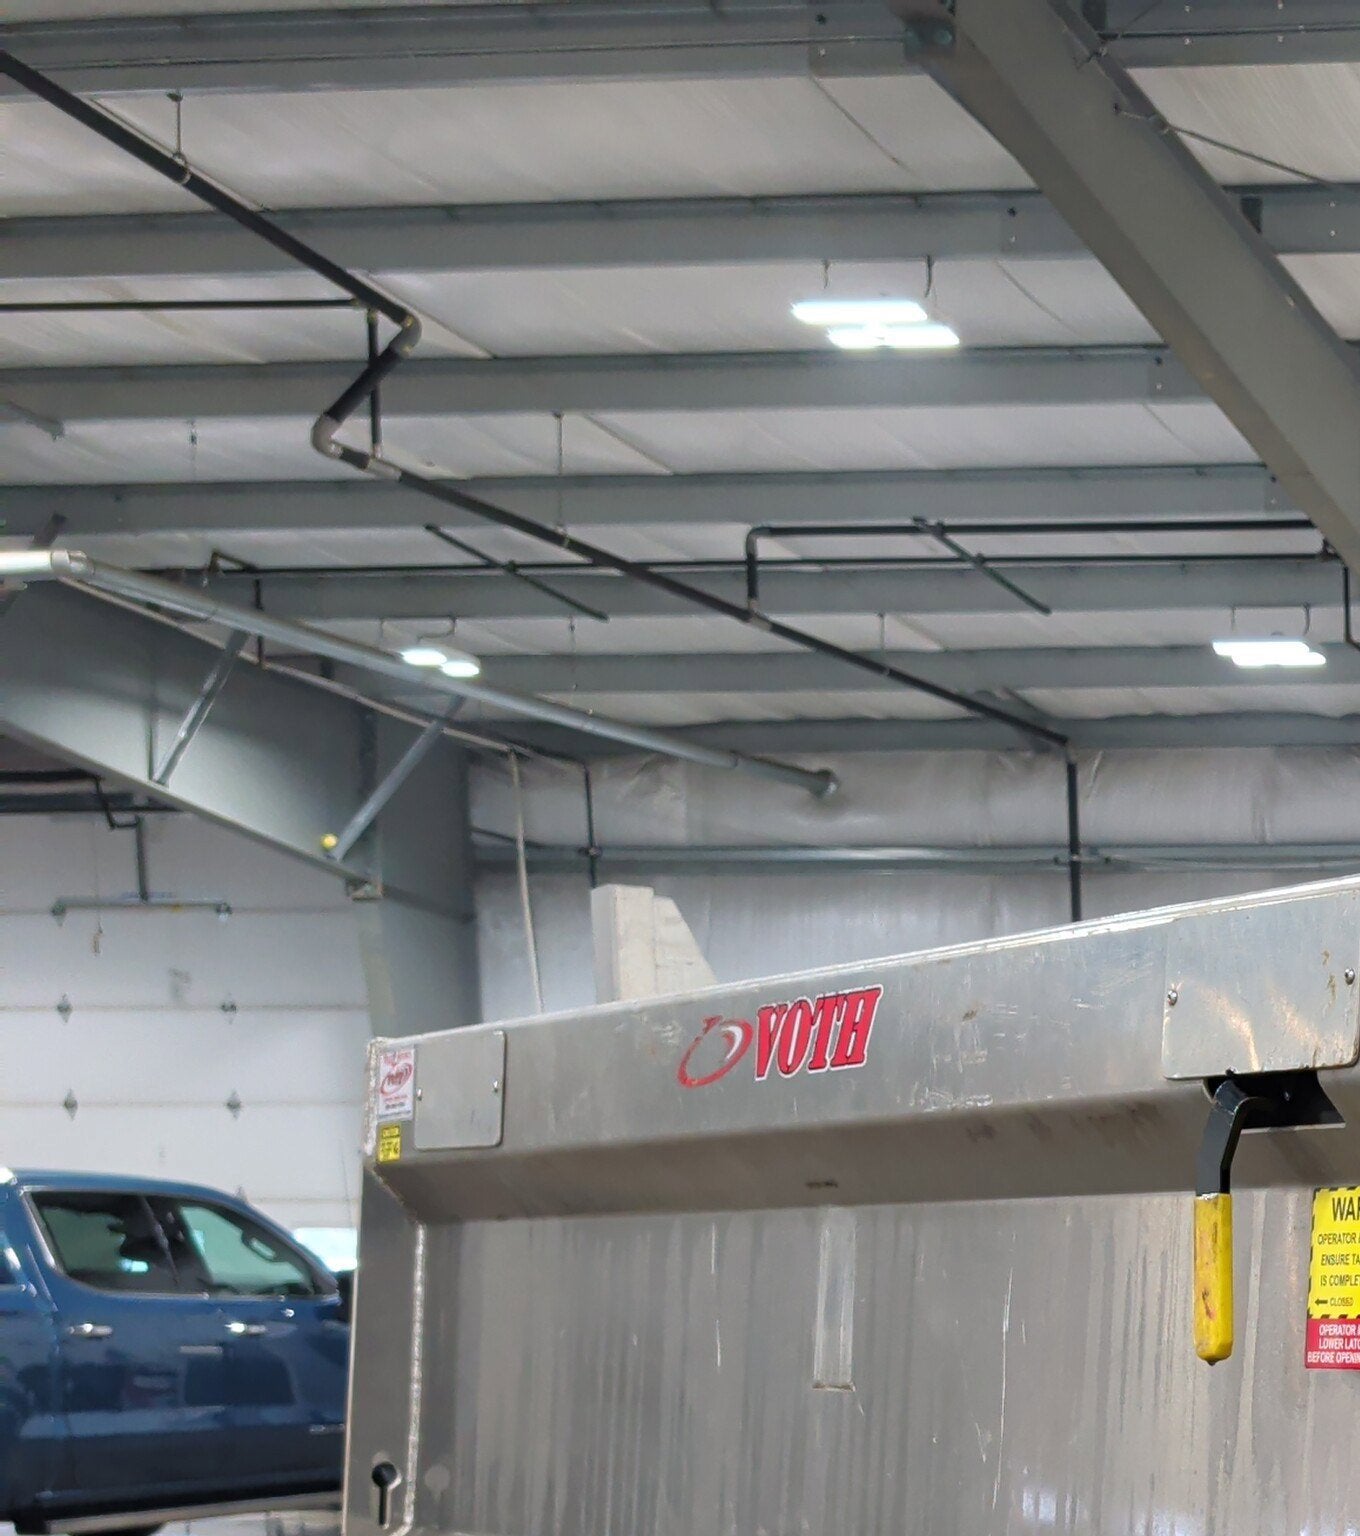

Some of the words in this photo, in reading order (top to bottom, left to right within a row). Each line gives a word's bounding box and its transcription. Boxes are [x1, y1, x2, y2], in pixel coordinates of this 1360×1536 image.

[755, 984, 883, 1081] VOTH
[1317, 1232, 1357, 1245] OPERATOR
[1321, 1253, 1350, 1266] ENSURE
[1320, 1275, 1327, 1287] IS
[1329, 1296, 1354, 1307] CLOSED
[1319, 1324, 1357, 1336] OPERATOR
[1318, 1338, 1343, 1349] LOWER
[1307, 1351, 1336, 1363] BEFORE
